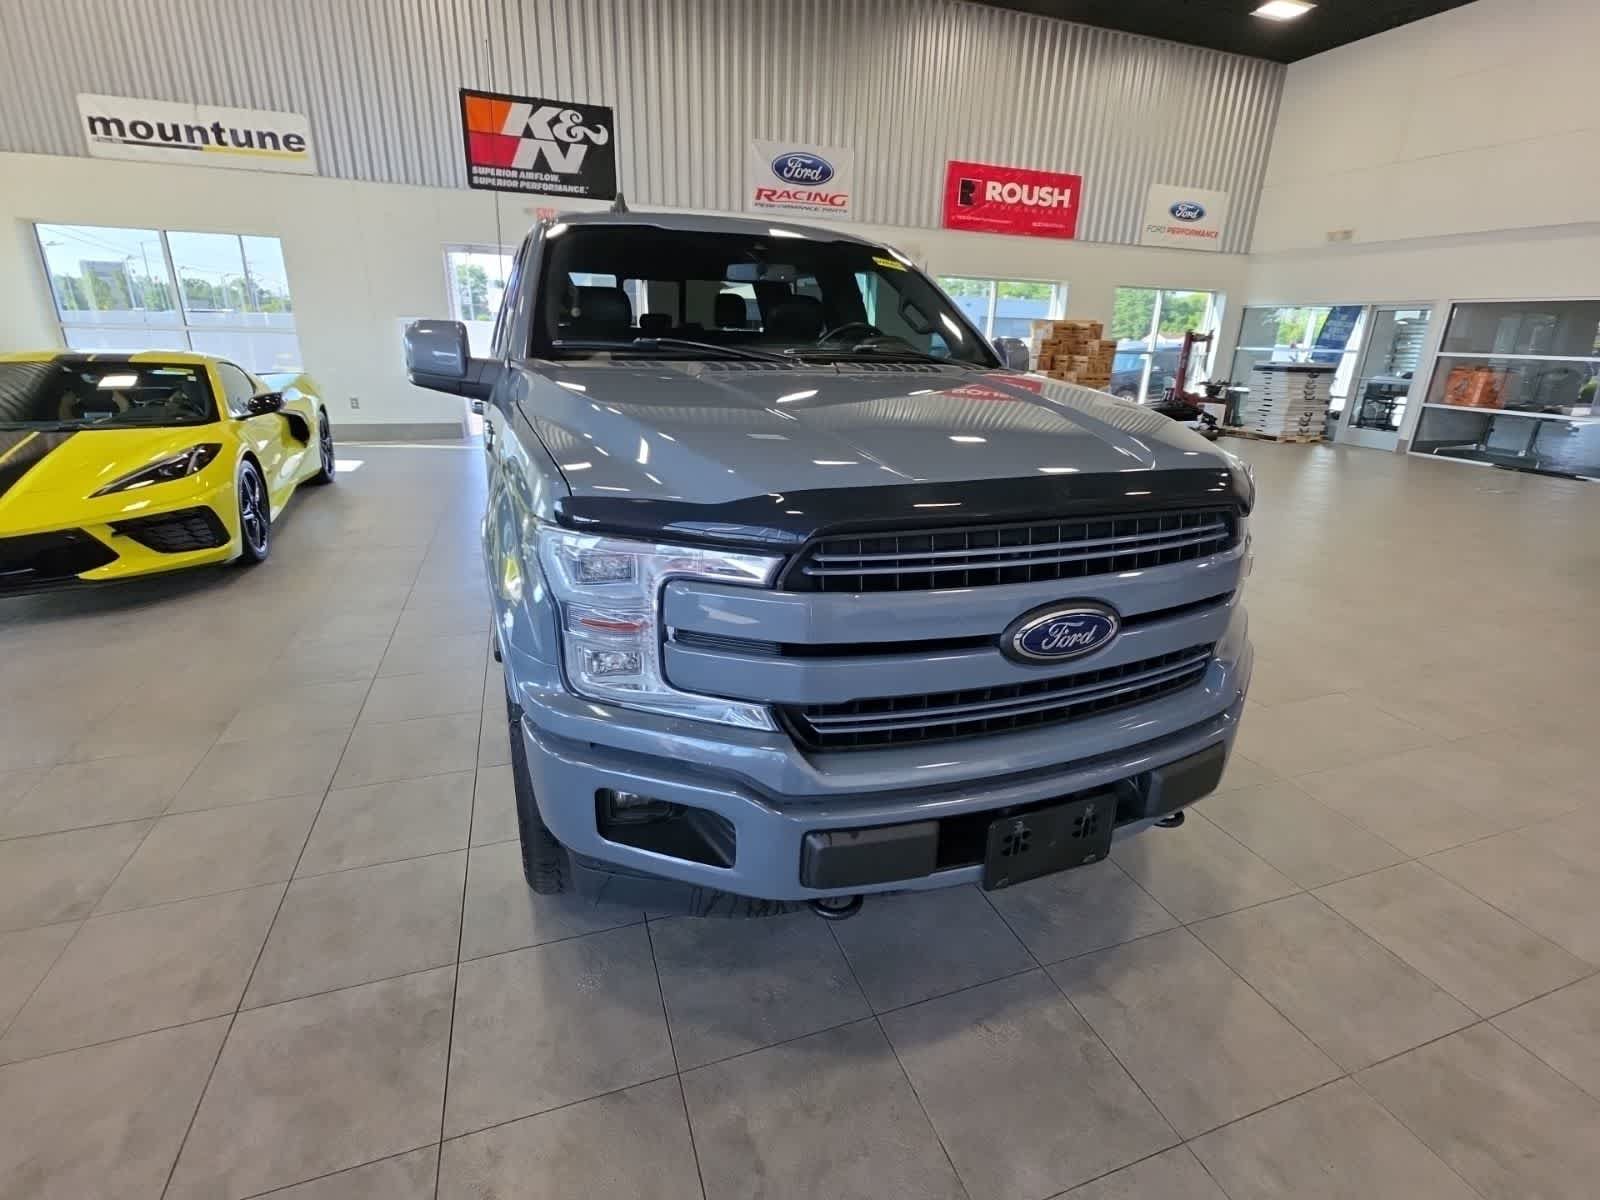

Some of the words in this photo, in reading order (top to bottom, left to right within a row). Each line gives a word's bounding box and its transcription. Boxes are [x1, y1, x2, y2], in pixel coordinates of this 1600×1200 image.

[87, 115, 305, 153] mountune
[472, 166, 519, 178] SUPERIOR
[783, 157, 823, 181] Ford
[472, 176, 519, 188] SUPERIOR
[755, 188, 849, 207] RACING
[985, 181, 1072, 209] ROUSH
[1175, 203, 1200, 219] Ford
[1041, 620, 1099, 650] Ford
